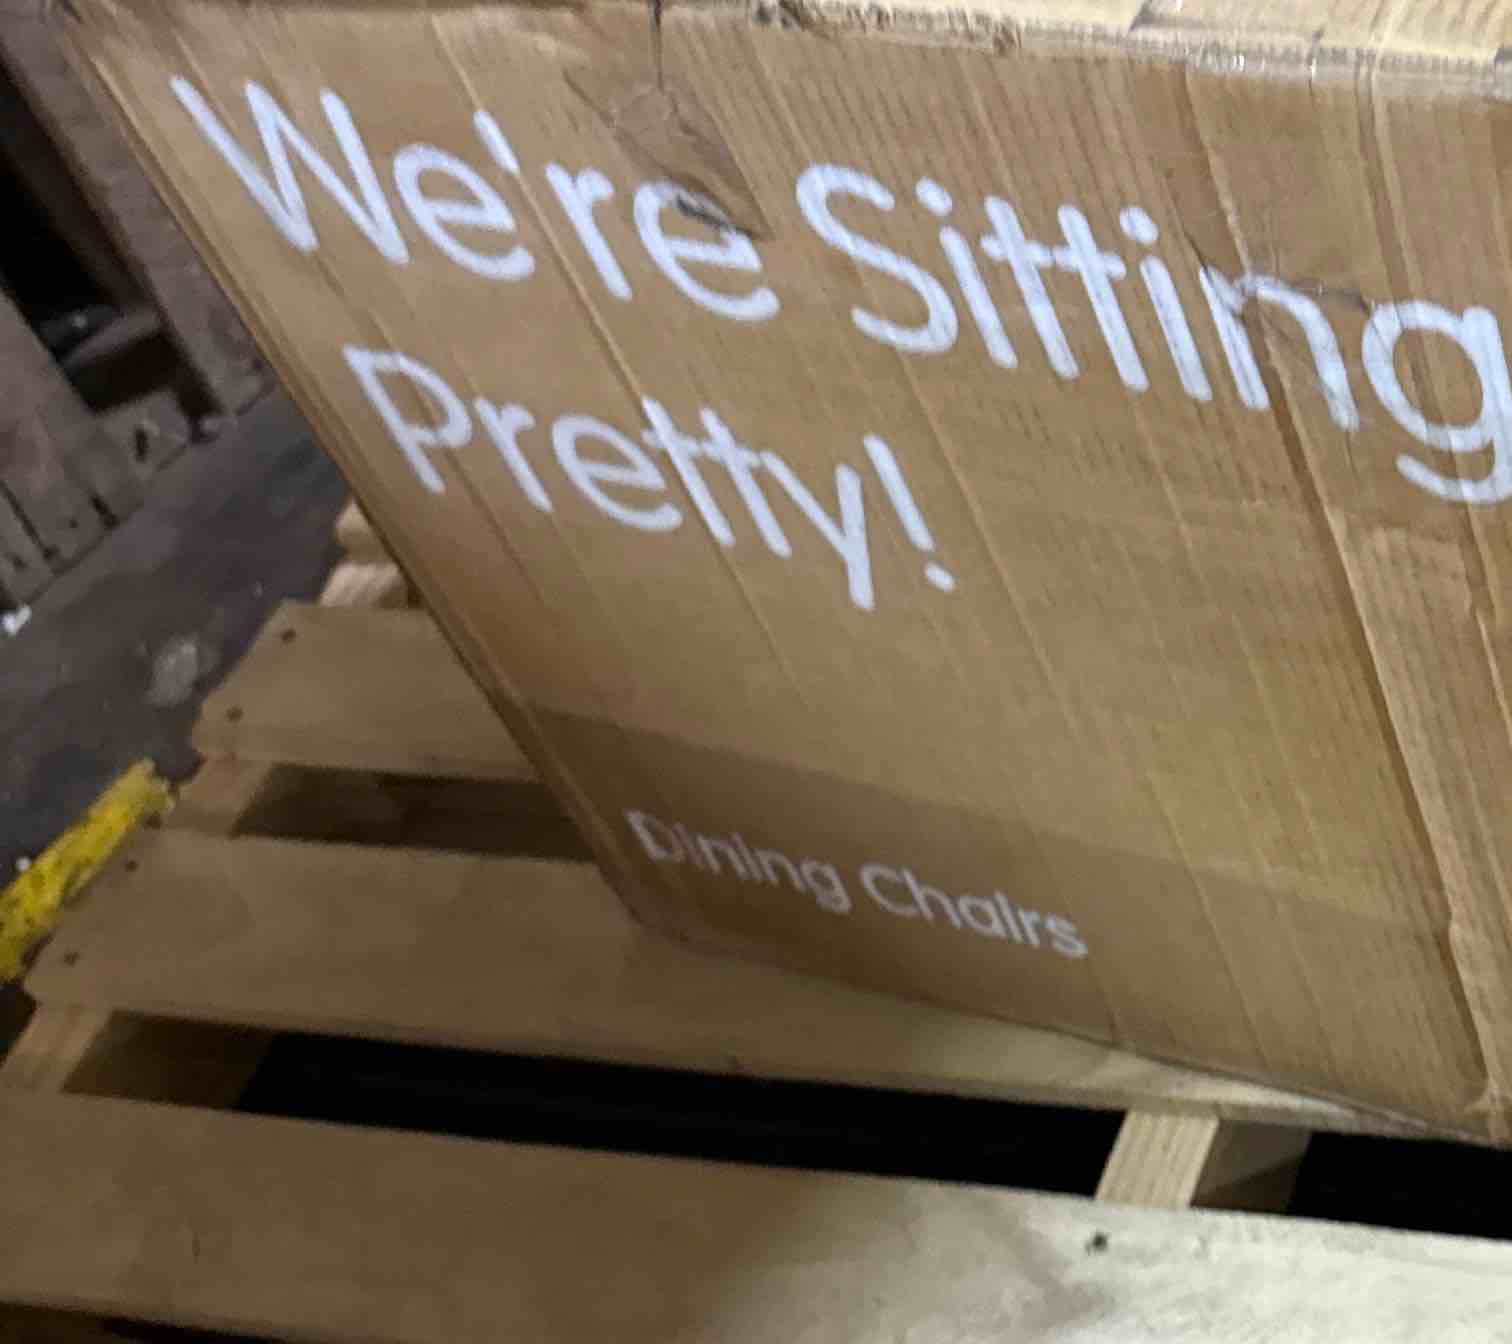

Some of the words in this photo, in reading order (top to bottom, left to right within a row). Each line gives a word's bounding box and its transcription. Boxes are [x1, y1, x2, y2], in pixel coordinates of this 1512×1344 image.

[170, 74, 780, 323] We're
[342, 344, 957, 612] Pretty!
[624, 809, 852, 913] Dining
[860, 861, 1090, 959] Chairs
